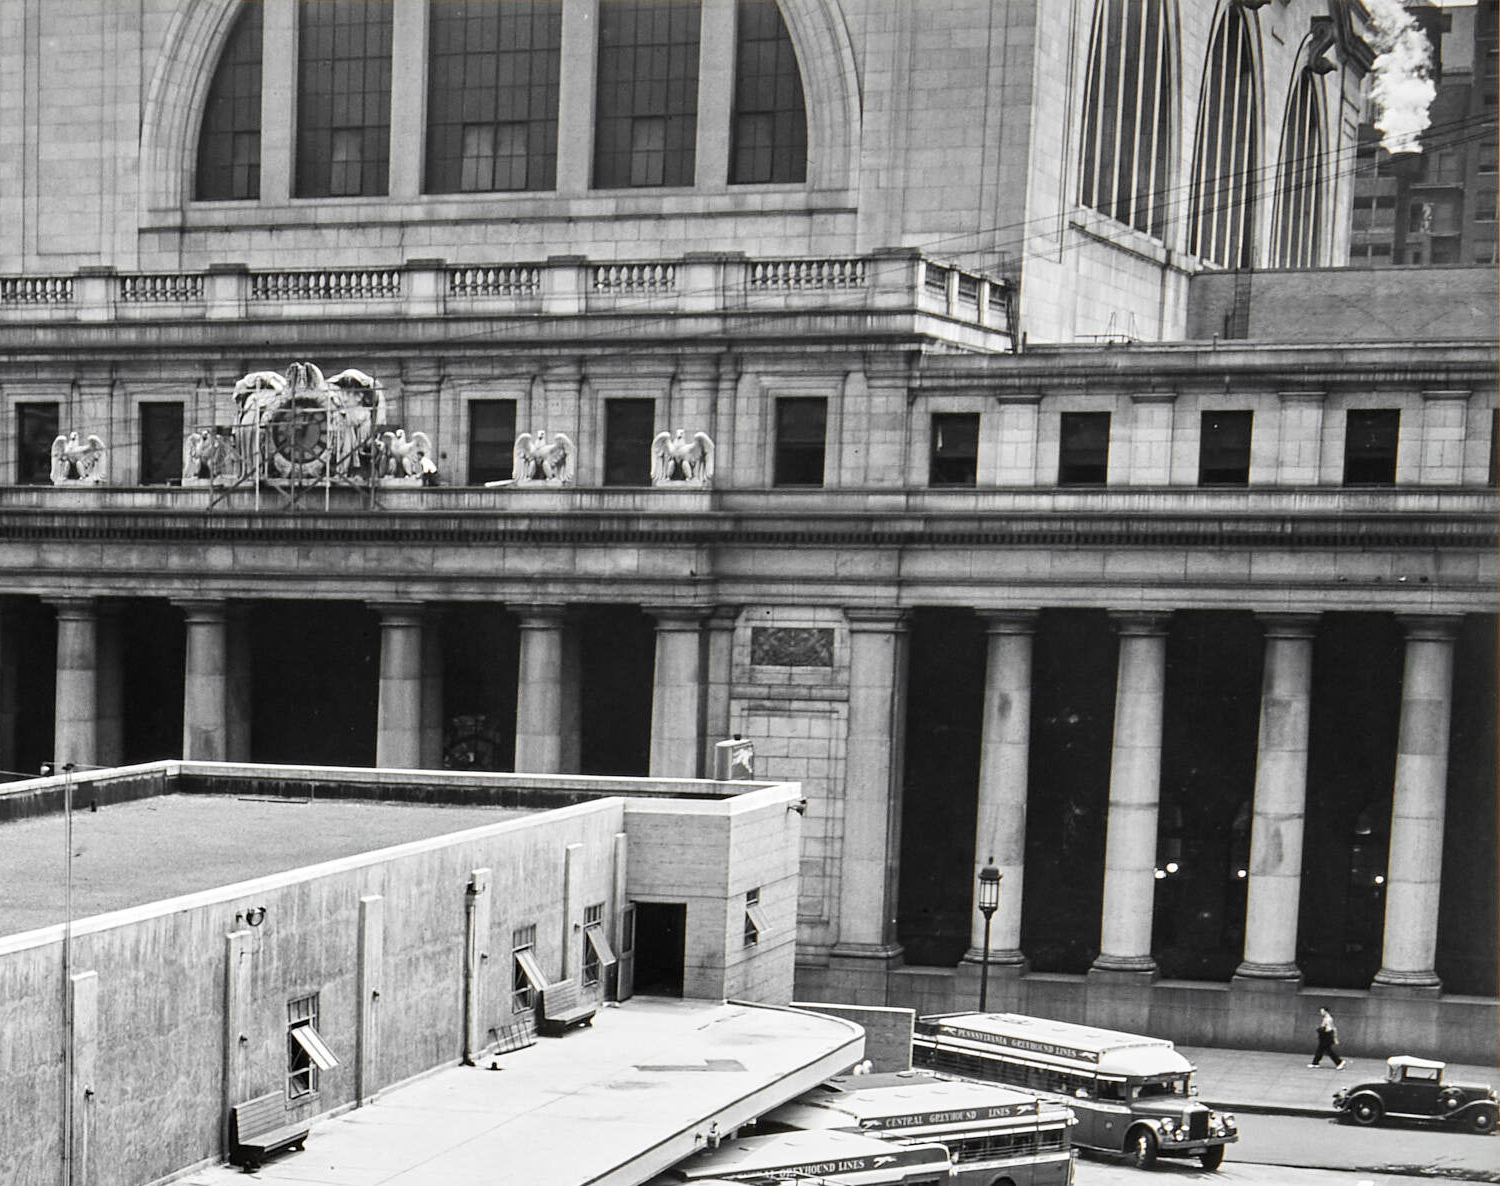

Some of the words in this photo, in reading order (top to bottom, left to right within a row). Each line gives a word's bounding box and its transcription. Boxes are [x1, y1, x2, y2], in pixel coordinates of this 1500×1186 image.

[1055, 1046, 1077, 1058] LINES
[885, 1115, 924, 1127] CENTRAL
[929, 1110, 977, 1123] GREYHOUND
[988, 1107, 1011, 1118] LINES
[838, 1159, 865, 1172] LINES
